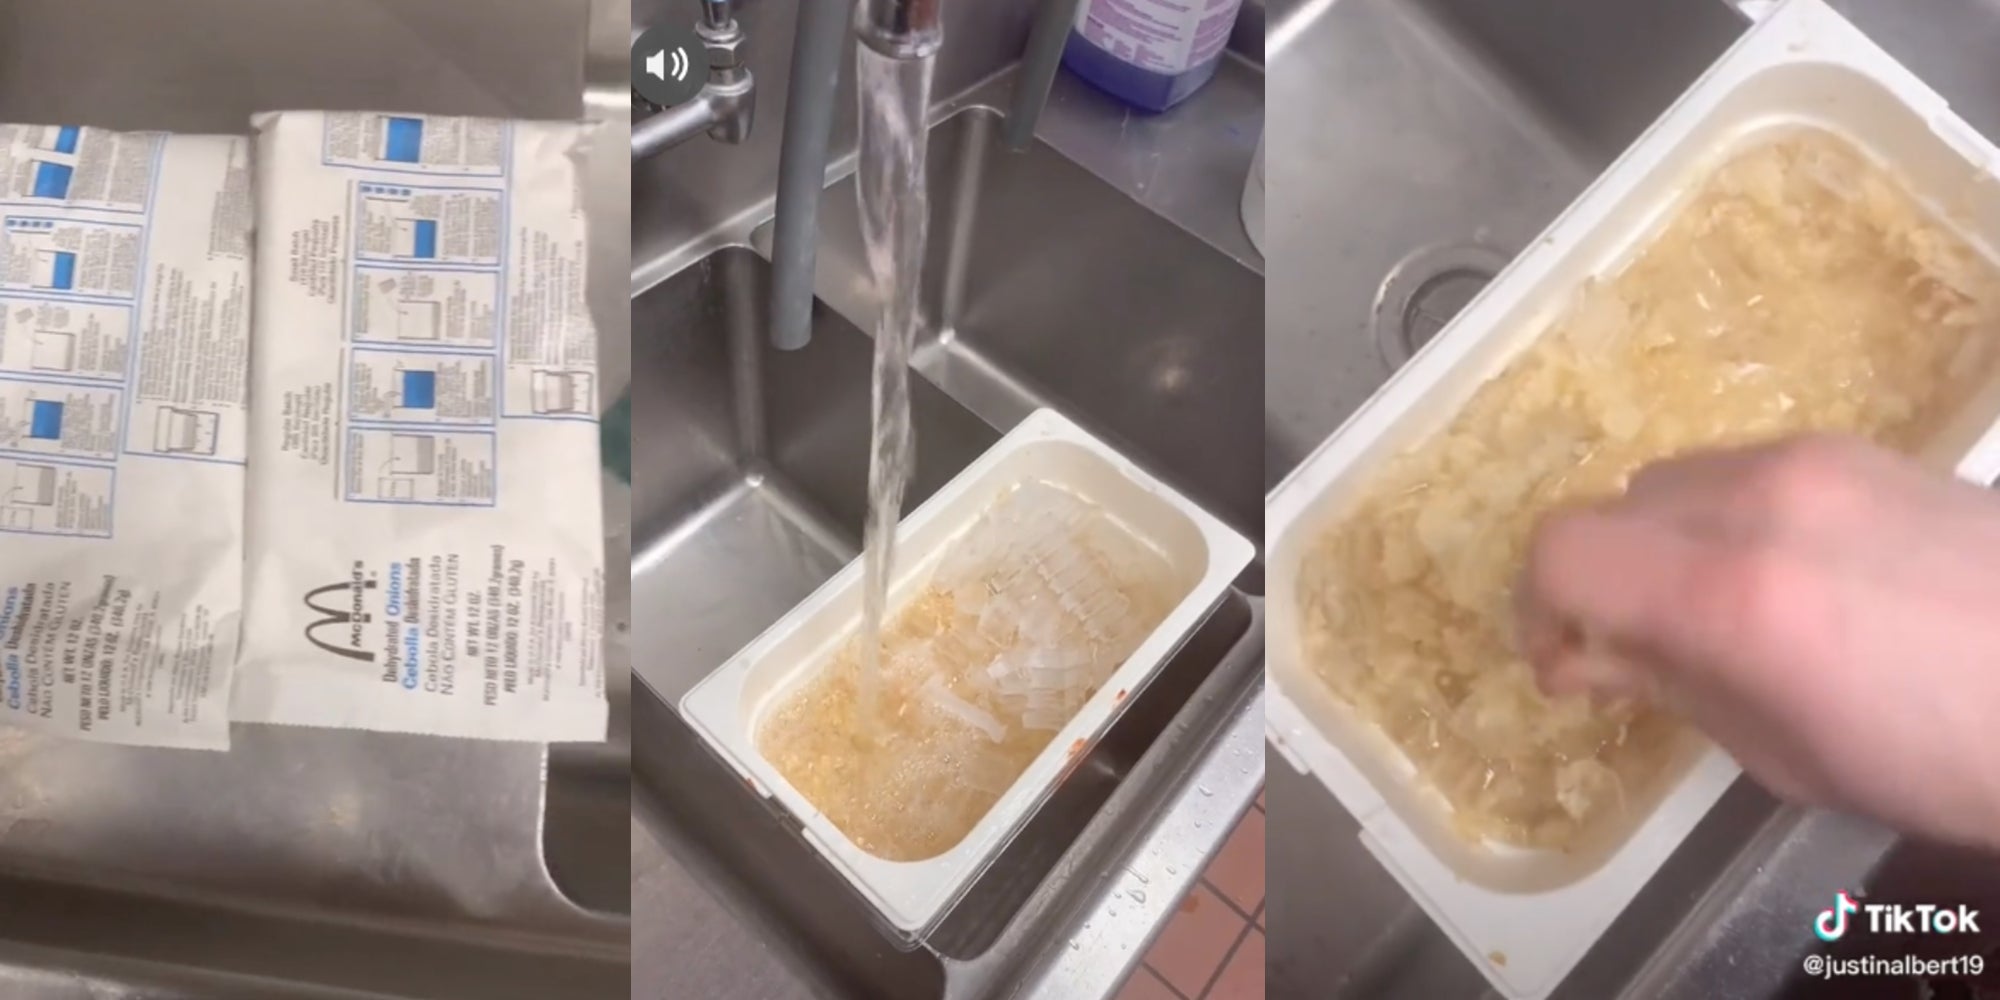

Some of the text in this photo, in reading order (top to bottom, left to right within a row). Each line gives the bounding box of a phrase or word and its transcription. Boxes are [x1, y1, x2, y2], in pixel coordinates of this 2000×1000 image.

[443, 554, 458, 605] GLUTEN
[350, 561, 364, 647] McDonald's
[468, 607, 480, 617] 12
[382, 562, 401, 682] Dehydrated Onions
[402, 558, 420, 689] Cebolla Deshidratada
[424, 556, 441, 692] Cebola Desidratada
[508, 617, 519, 627] 12
[67, 633, 79, 644] 12
[467, 640, 478, 657] NET
[486, 642, 498, 652] 12
[81, 671, 92, 681] 12
[485, 657, 497, 680] NETO
[5, 654, 20, 709] Cebolla
[484, 682, 497, 706] PESO
